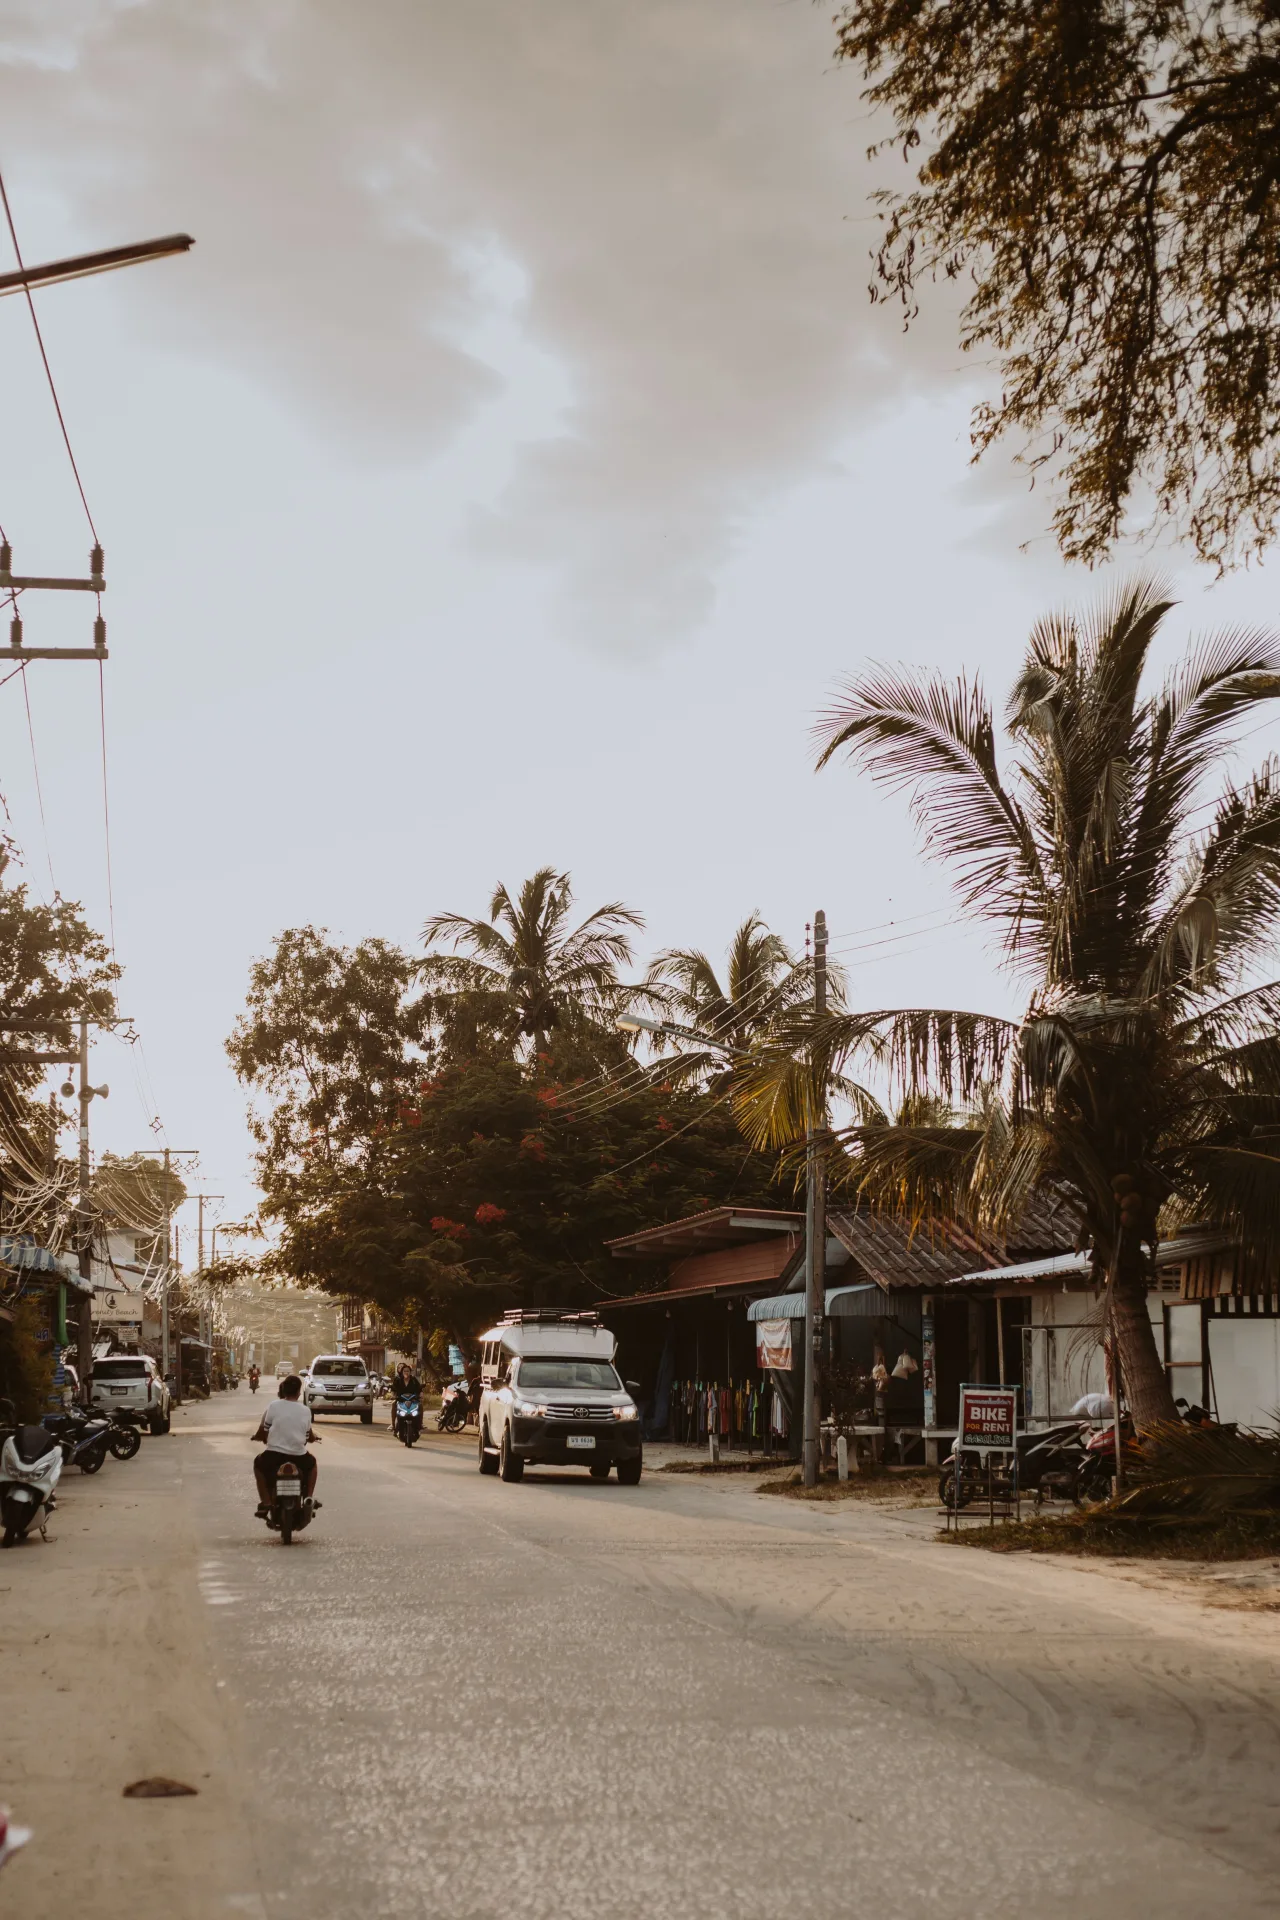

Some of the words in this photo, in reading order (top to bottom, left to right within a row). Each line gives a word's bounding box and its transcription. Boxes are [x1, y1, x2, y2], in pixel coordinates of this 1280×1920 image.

[970, 1406, 1007, 1421] BIKE
[982, 1422, 1011, 1432] RENT
[964, 1433, 1011, 1445] GASOLINE
